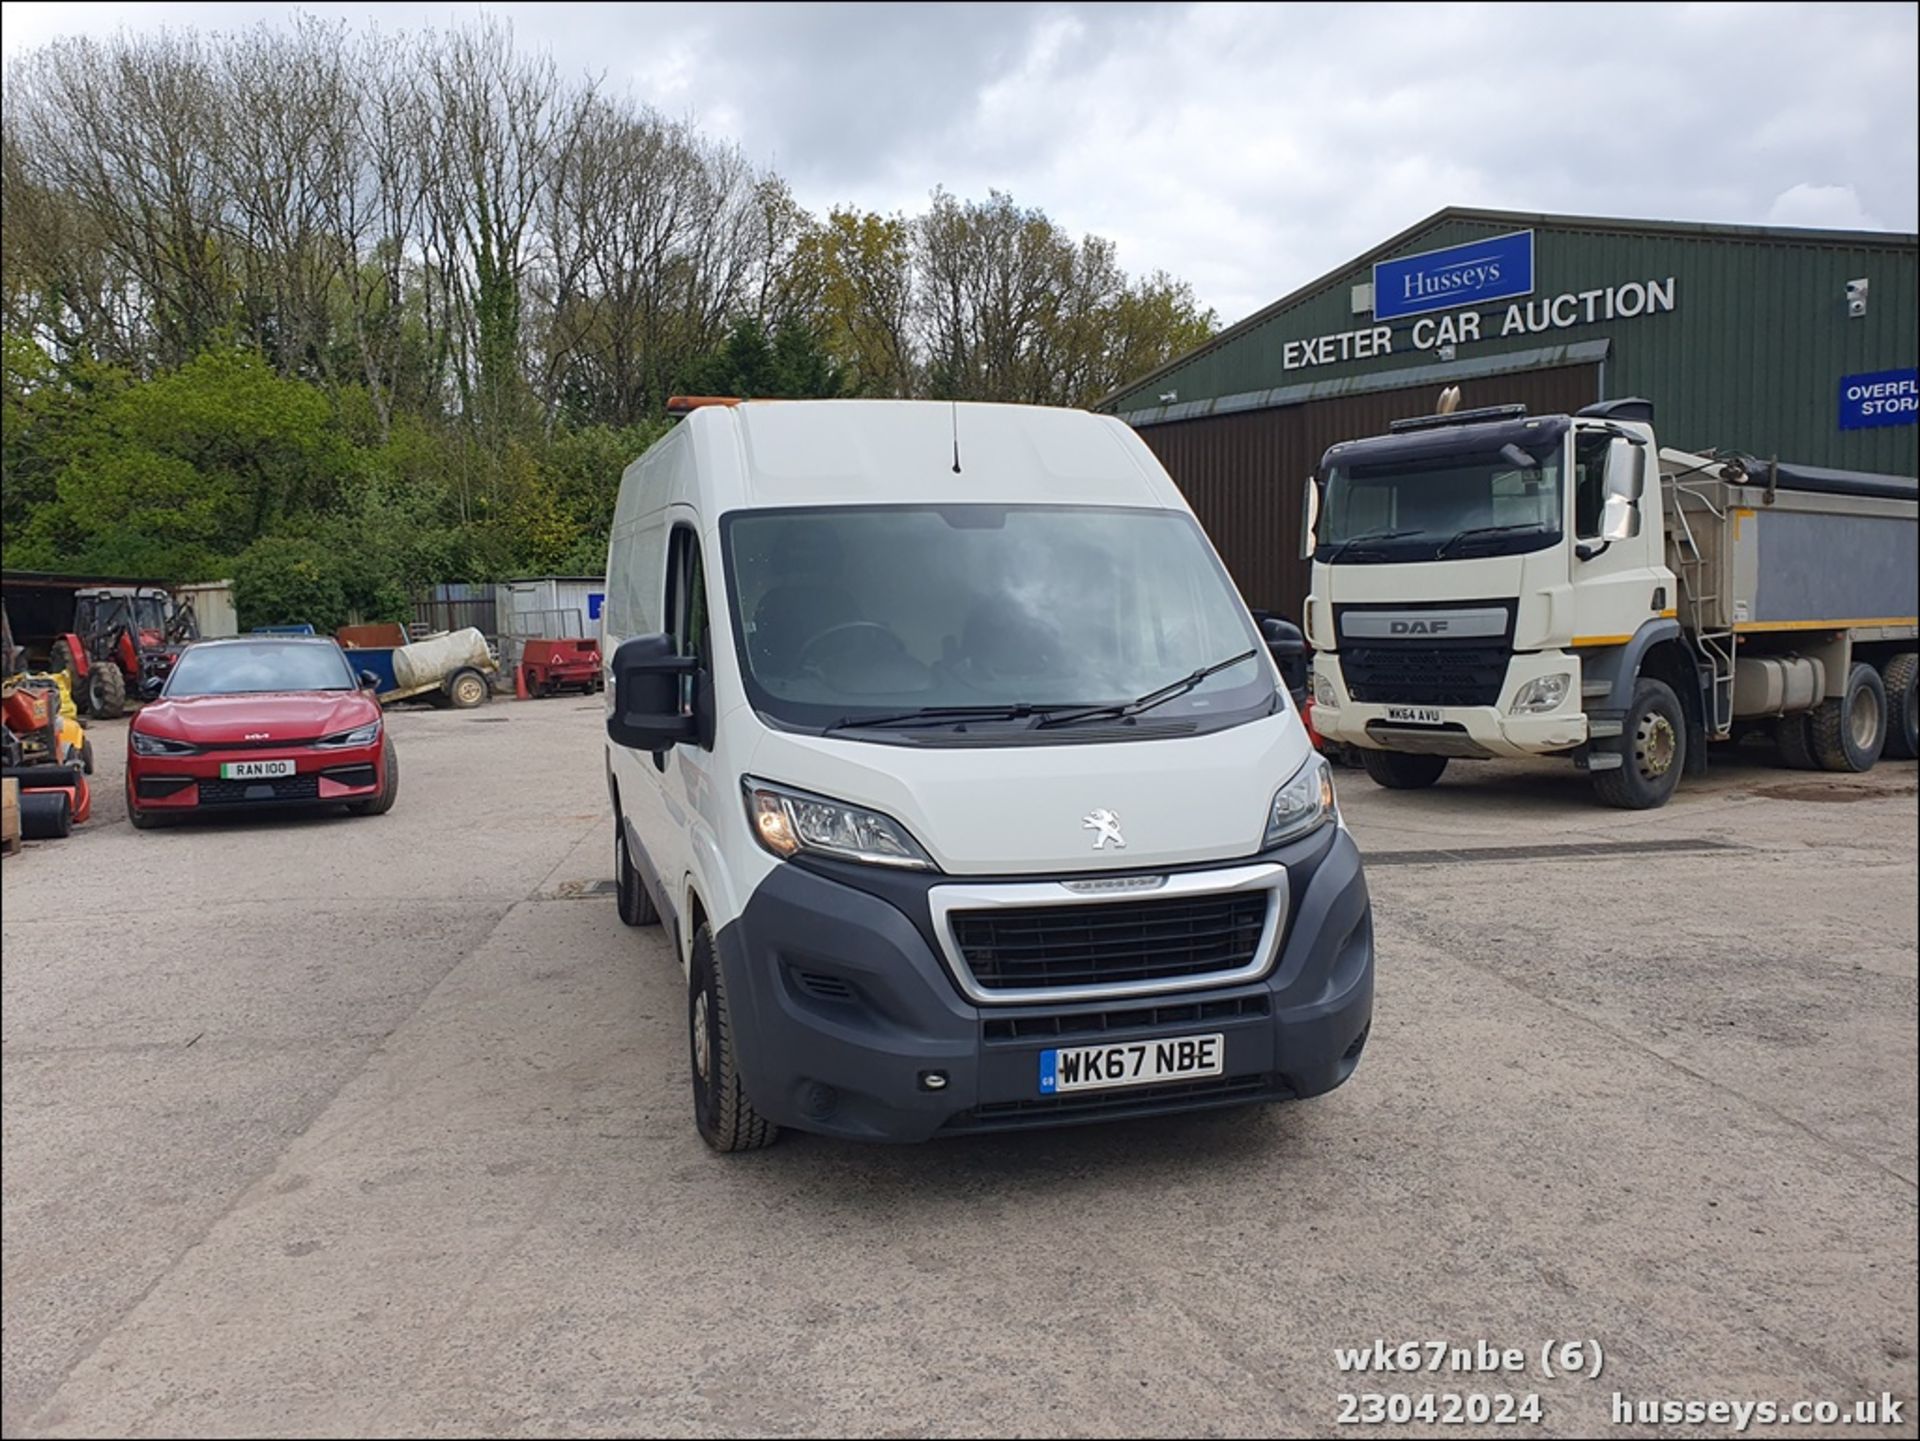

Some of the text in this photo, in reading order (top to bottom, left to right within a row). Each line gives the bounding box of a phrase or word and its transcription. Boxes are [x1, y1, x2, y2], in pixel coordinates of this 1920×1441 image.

[1403, 263, 1500, 298] Husseys
[1283, 277, 1675, 370] EXETER CAR AUCTION
[1390, 621, 1448, 634] DAF
[236, 764, 263, 776] RAN
[1060, 1039, 1216, 1083] WK67 NBE
